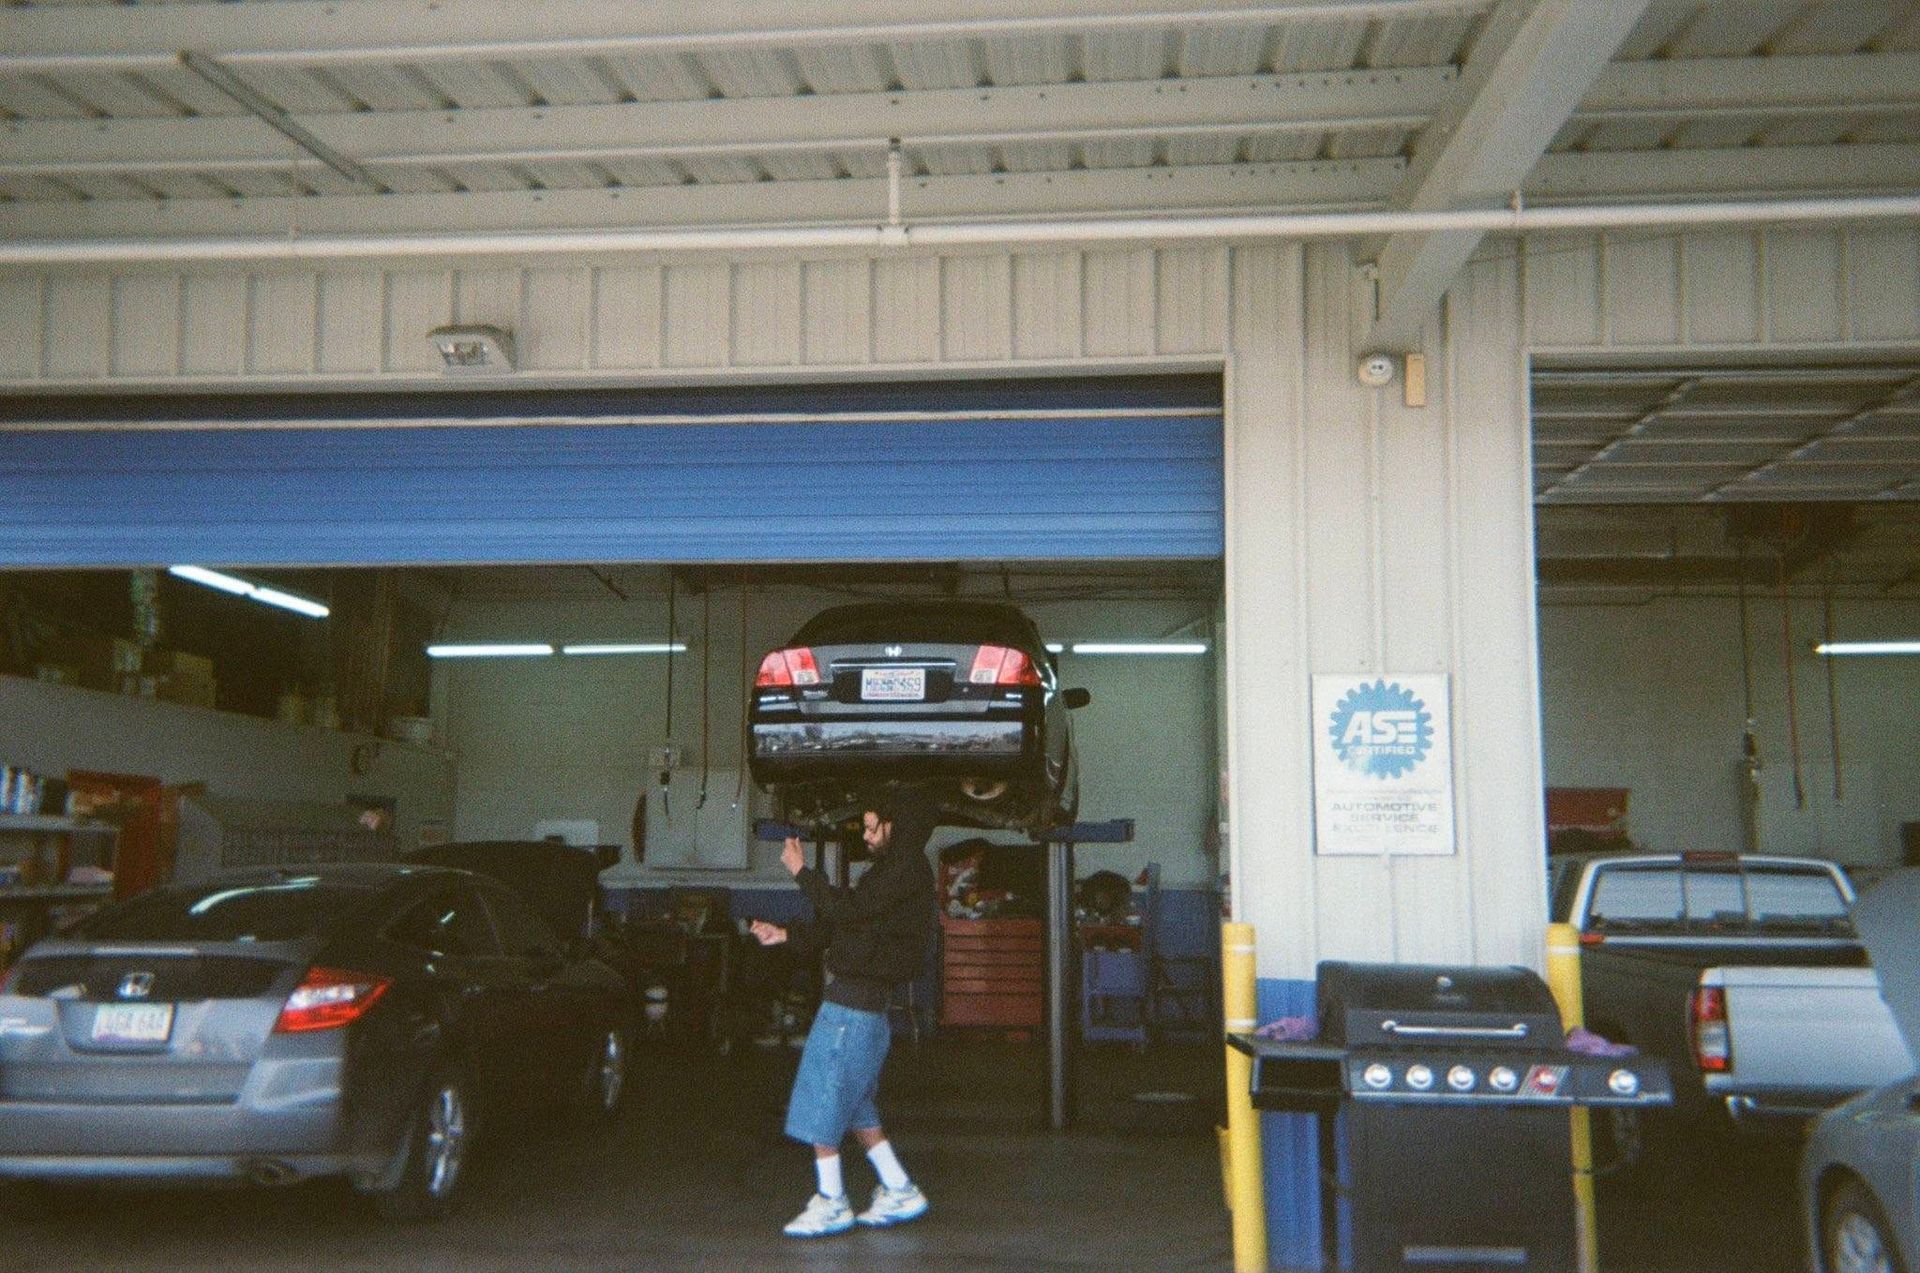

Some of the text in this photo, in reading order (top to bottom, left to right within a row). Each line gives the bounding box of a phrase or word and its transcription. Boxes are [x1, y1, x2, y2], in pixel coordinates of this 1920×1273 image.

[1343, 710, 1417, 744] ASE
[1346, 745, 1416, 756] CTIFIED
[1332, 802, 1438, 812] AUTOMOTIVE
[1351, 813, 1419, 823] SERVICE
[1332, 824, 1439, 834] EXCLENCE
